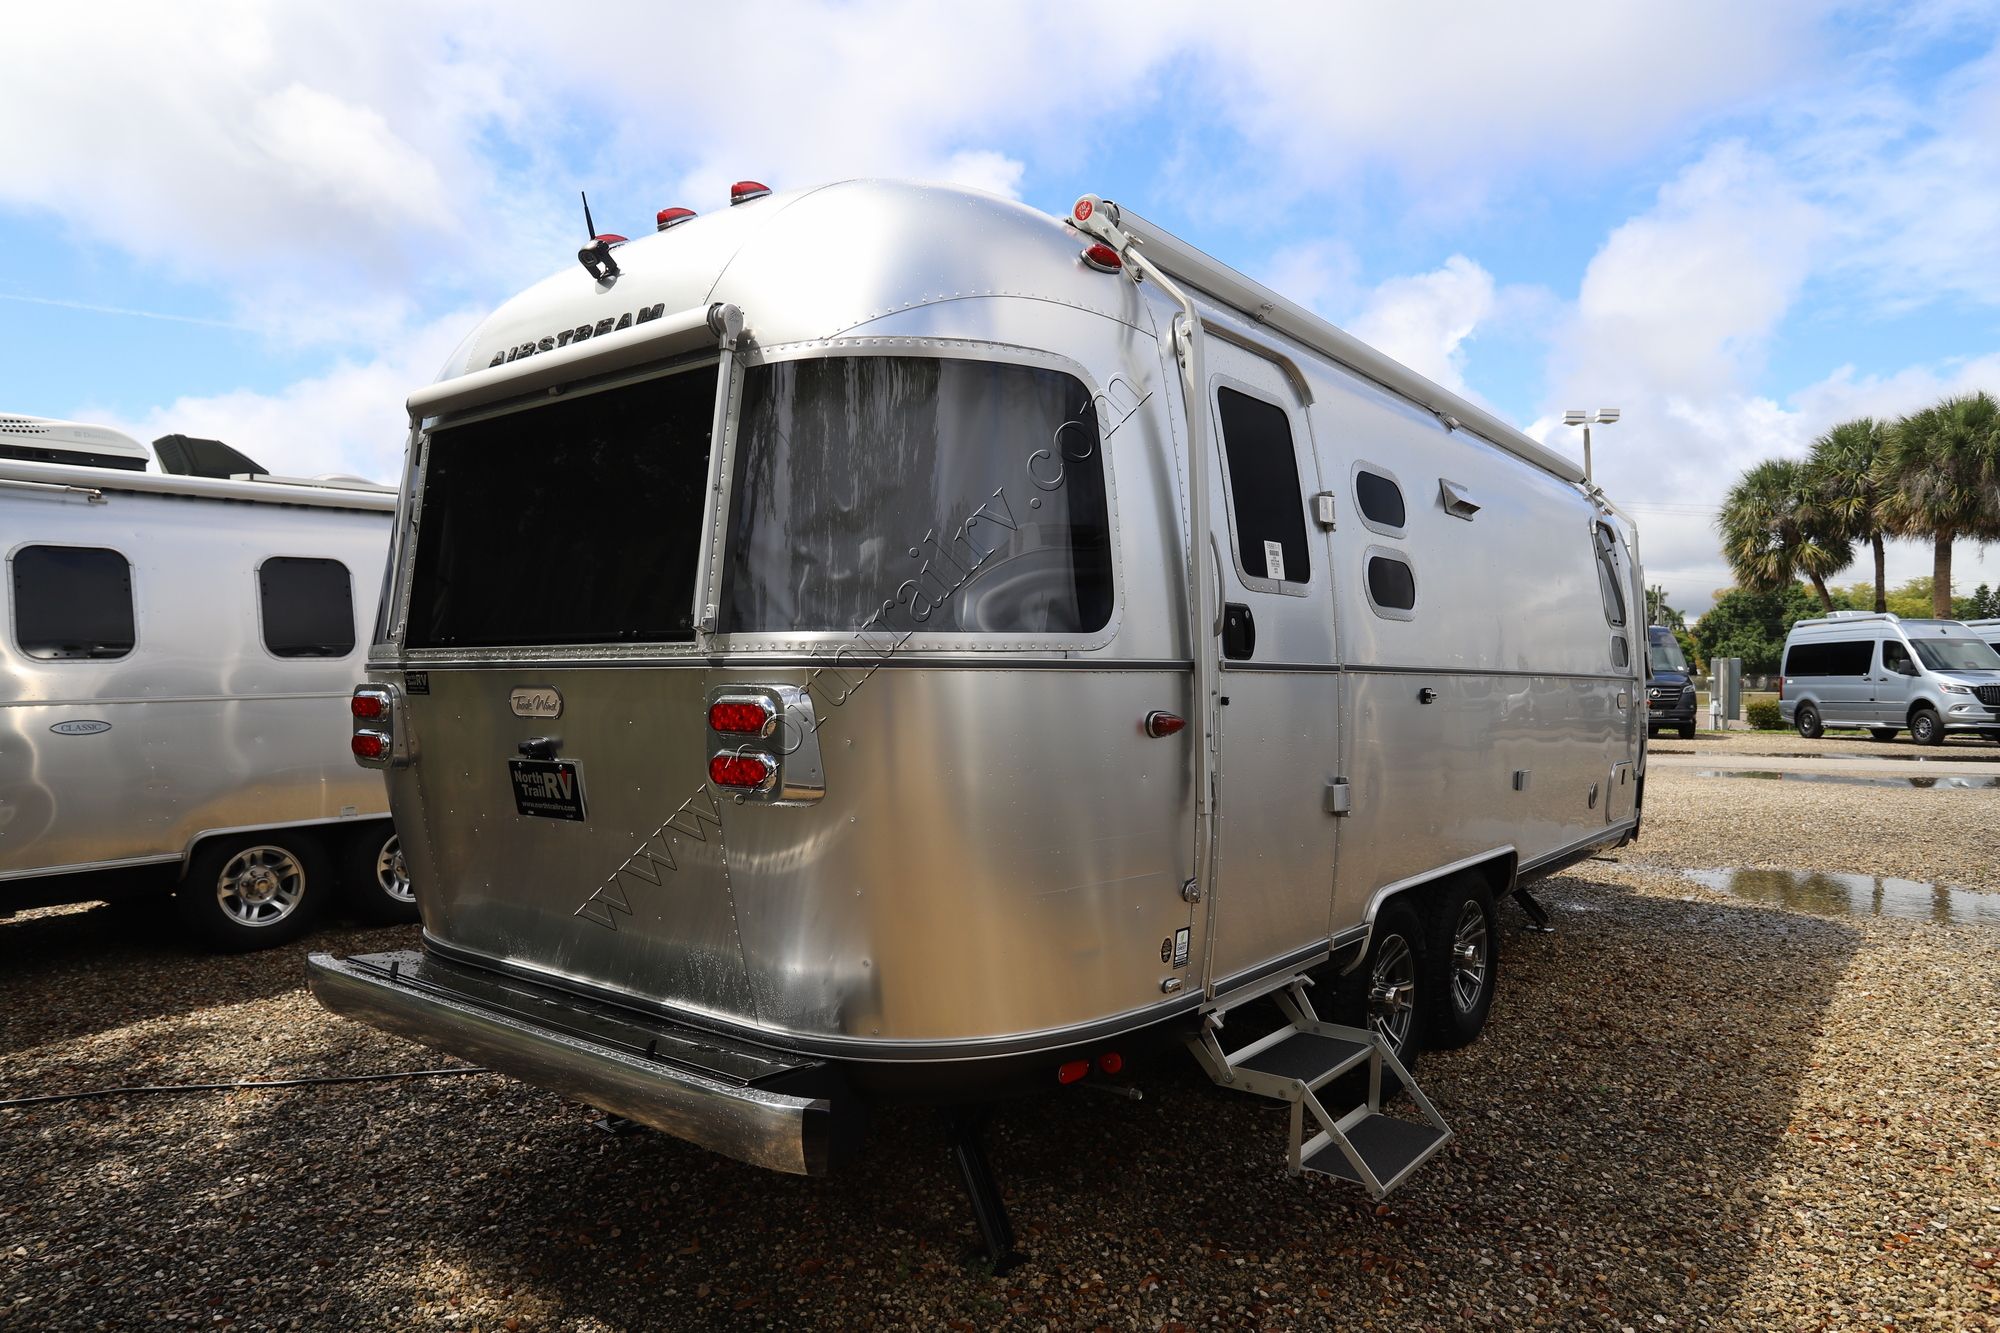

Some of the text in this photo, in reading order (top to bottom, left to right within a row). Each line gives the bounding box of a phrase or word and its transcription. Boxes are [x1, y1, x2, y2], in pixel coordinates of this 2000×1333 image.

[489, 303, 665, 368] AIRSTREAM
[61, 724, 102, 732] CLASSIC
[514, 770, 543, 784] North
[522, 784, 545, 797] Trail
[542, 771, 573, 800] RV
